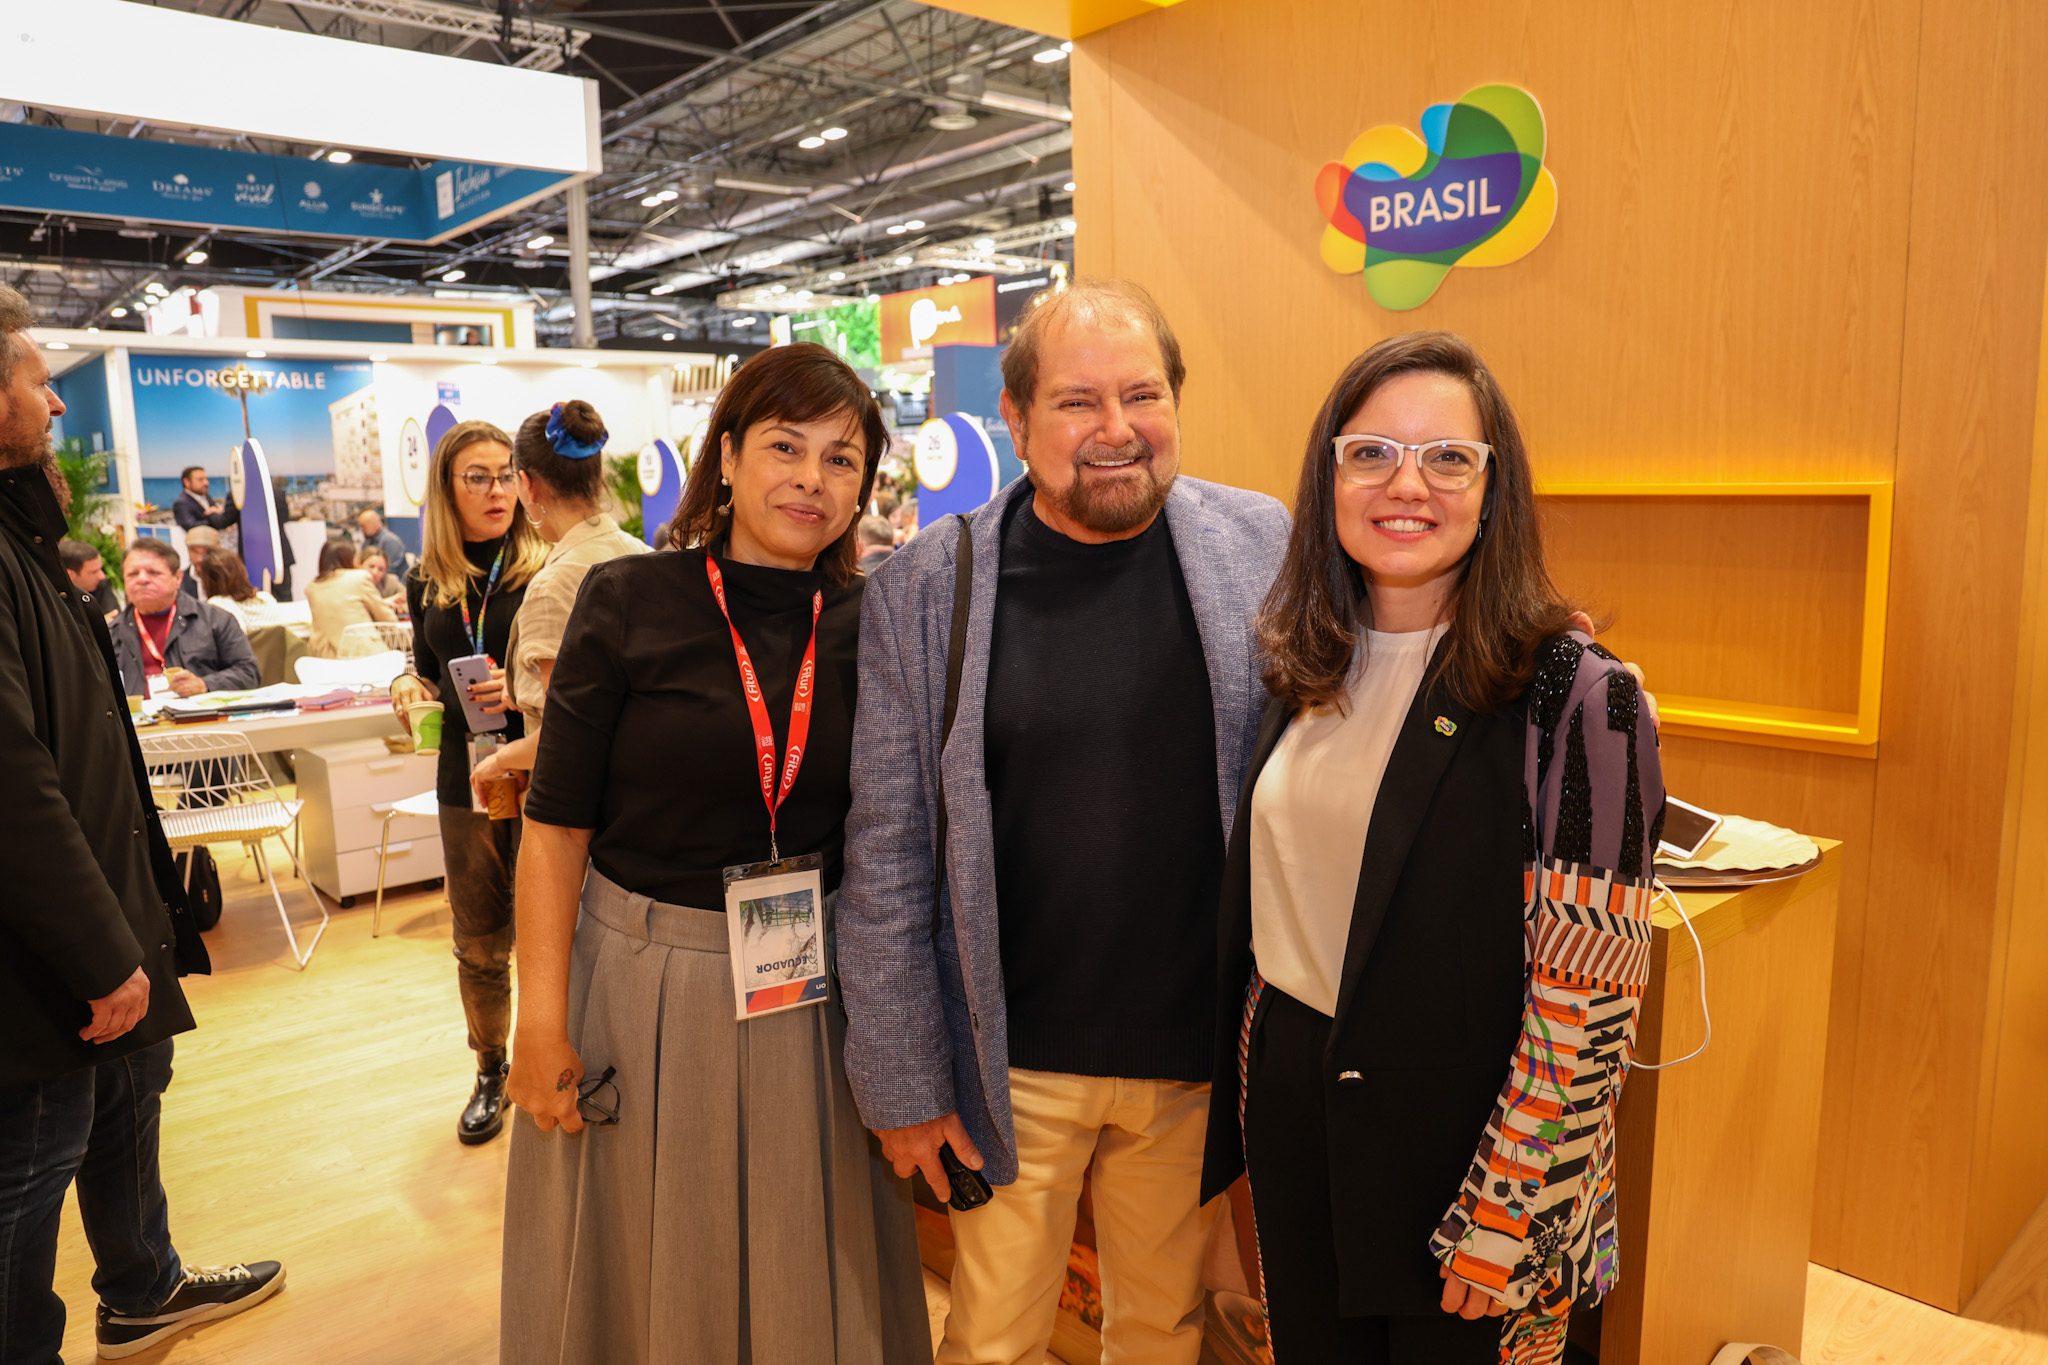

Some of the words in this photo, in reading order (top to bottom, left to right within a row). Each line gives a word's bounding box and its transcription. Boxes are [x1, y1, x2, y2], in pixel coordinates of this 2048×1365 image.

[152, 180, 213, 197] DREAMS
[1369, 177, 1502, 233] BRASIL
[136, 366, 327, 391] UNFORGETTABLE
[743, 667, 758, 694] Fitur
[799, 666, 812, 691] Fitur
[762, 761, 773, 790] Fitur
[784, 753, 800, 783] Fitur
[756, 955, 808, 974] ECUADOR
